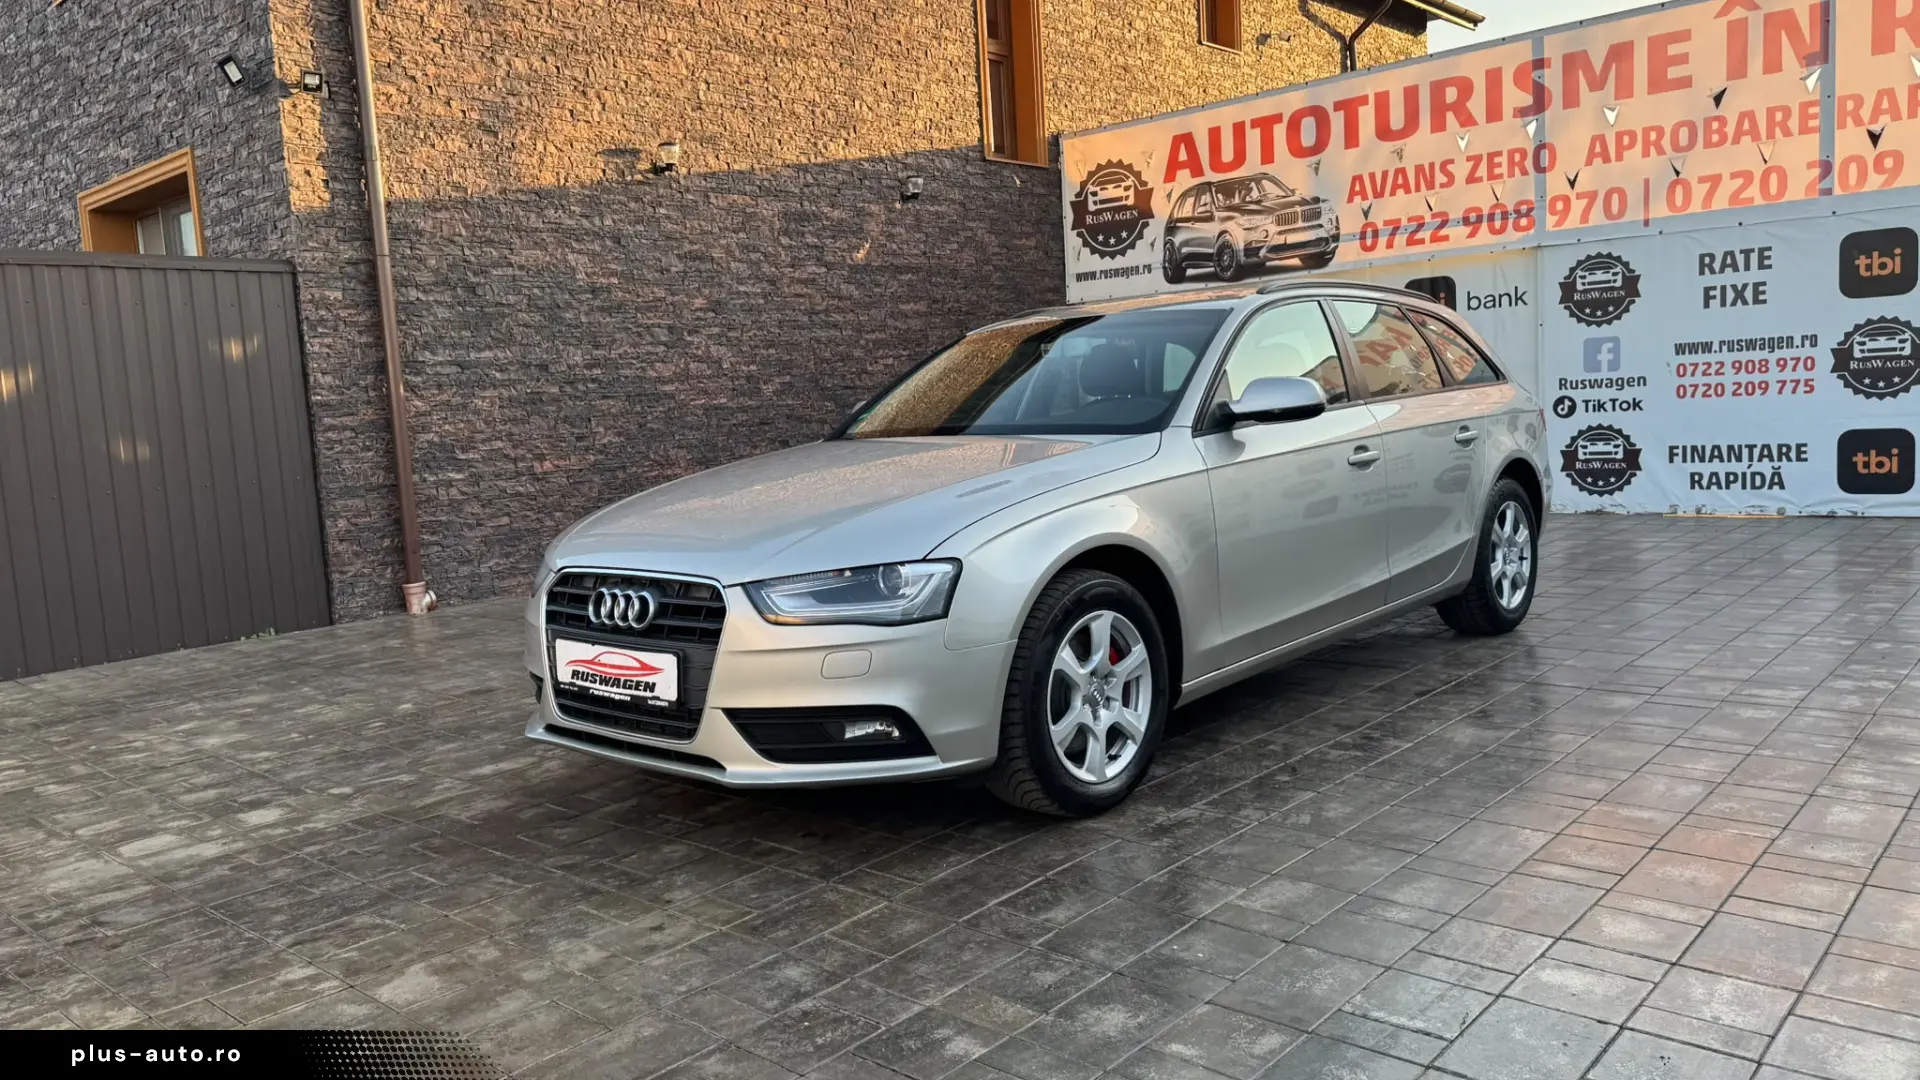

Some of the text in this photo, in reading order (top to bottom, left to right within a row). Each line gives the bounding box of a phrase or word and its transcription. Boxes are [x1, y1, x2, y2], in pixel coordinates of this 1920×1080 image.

[1163, 28, 1693, 184] AUTOTURISME
[1713, 0, 1830, 81] ÎN
[1347, 158, 1455, 204] AVANS
[1465, 142, 1557, 185] ZERO
[1584, 99, 1821, 167] APROBARE
[1359, 211, 1450, 253] 0722
[1462, 199, 1536, 239] 908
[1548, 186, 1628, 228] 970
[1665, 165, 1788, 214] 0720
[1804, 149, 1905, 197] 209
[1075, 263, 1153, 283] www.ruswagen.ro
[1698, 246, 1773, 276] RATE
[1854, 247, 1902, 277] tbi
[1467, 286, 1528, 311] bank
[1702, 281, 1768, 309] FIXE
[1674, 333, 1818, 356] www.ruswagen.ro
[1675, 356, 1816, 378] 0722 908 970
[1558, 375, 1647, 391] Ruswagen
[1675, 378, 1816, 399] 0720 209 775
[1581, 397, 1644, 413] TikTok
[1852, 448, 1899, 474] tbi
[571, 669, 656, 693] RUSWAGEN
[589, 688, 631, 701] ruswagen
